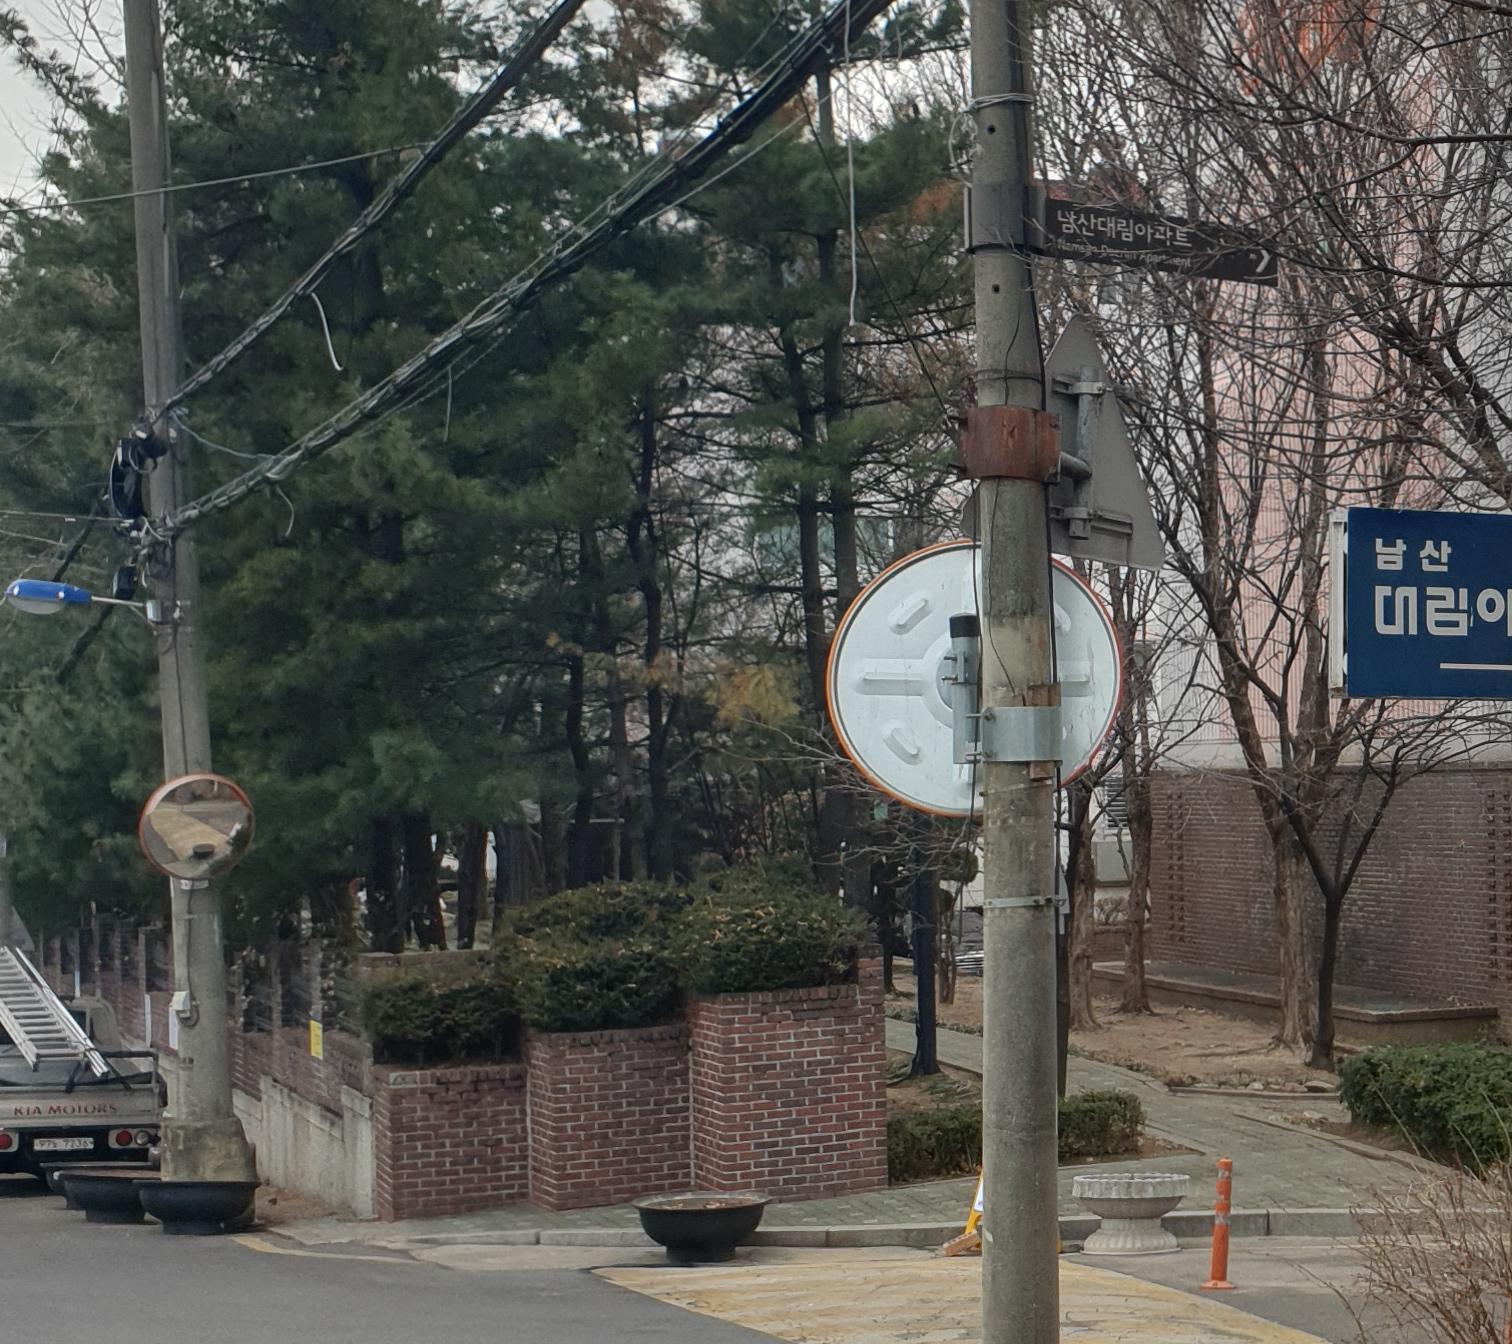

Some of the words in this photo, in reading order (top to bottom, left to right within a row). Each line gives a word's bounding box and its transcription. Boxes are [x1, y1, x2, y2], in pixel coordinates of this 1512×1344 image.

[1374, 537, 1452, 573] 남산
[13, 1105, 42, 1116] KIA
[47, 1103, 118, 1115] MOTORS
